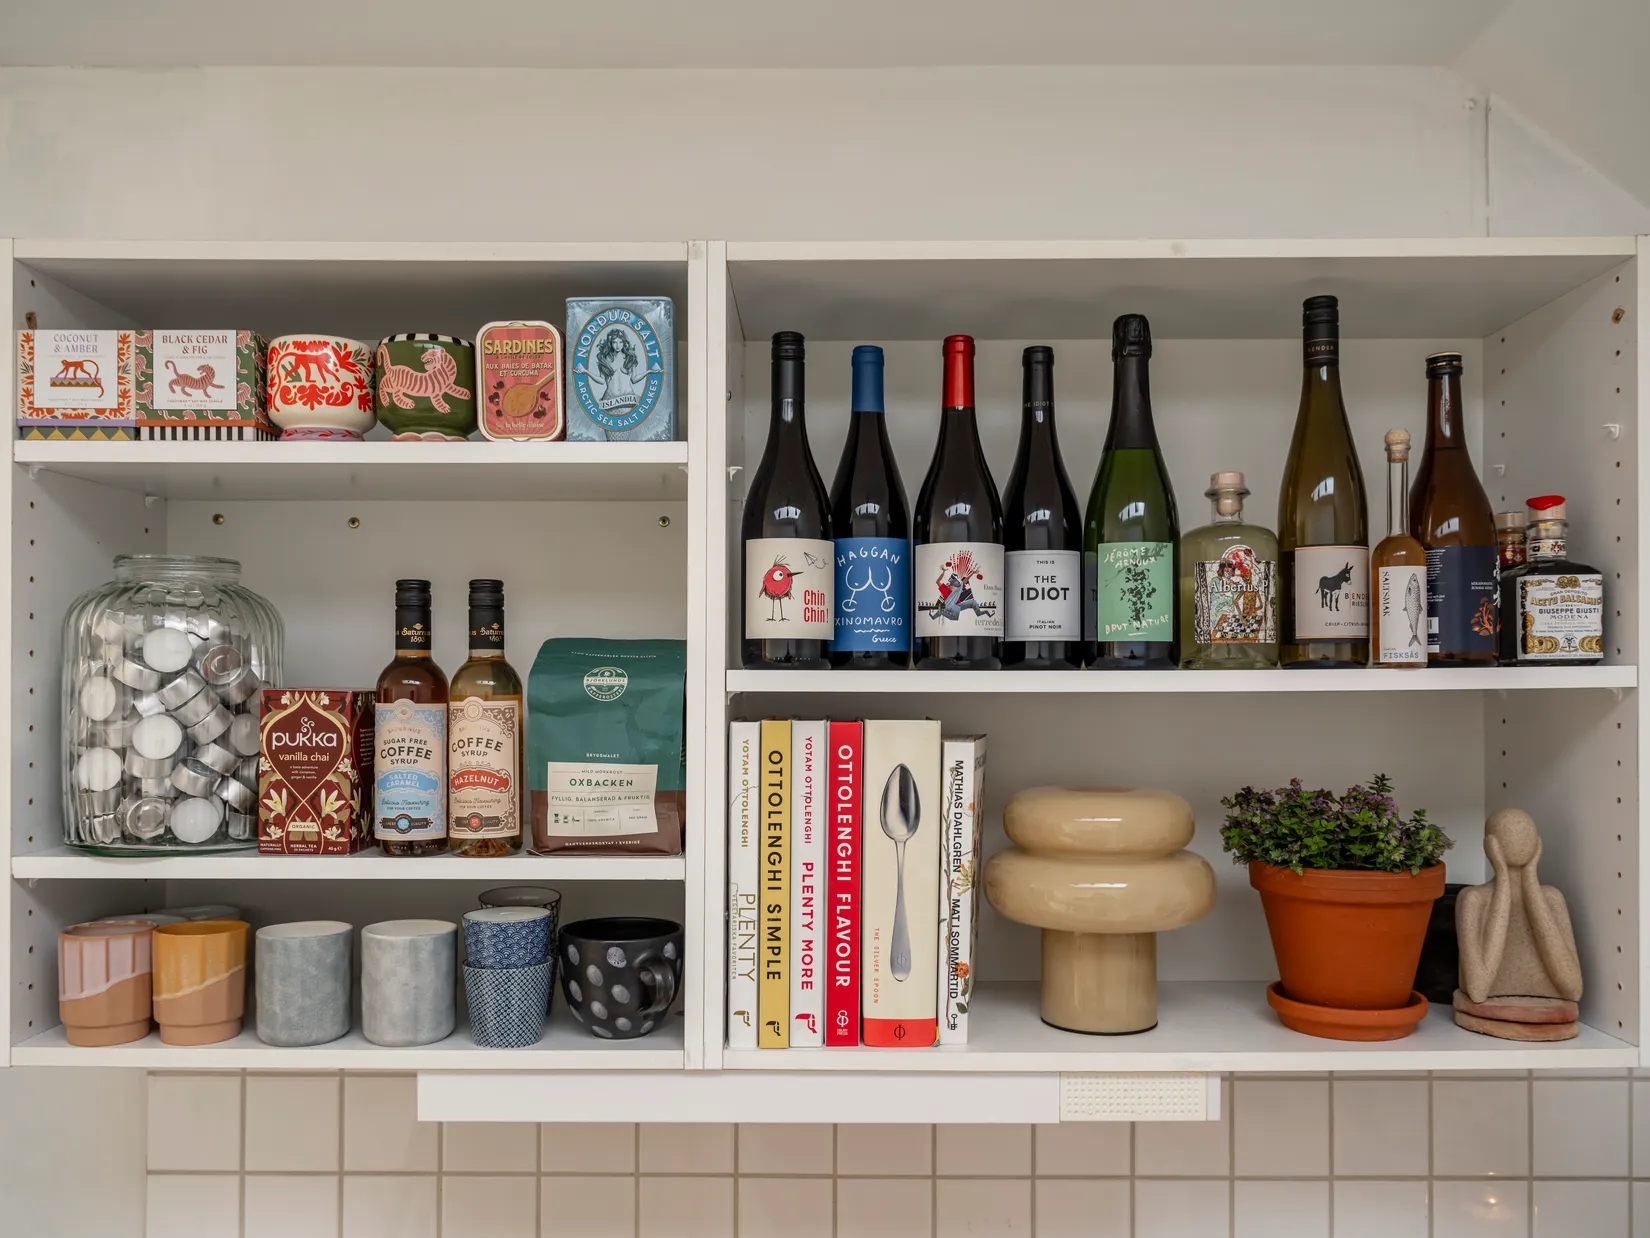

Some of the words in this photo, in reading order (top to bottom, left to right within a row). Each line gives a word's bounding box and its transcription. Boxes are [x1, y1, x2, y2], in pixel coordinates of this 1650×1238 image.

[54, 334, 99, 342] COCONUT
[162, 335, 193, 344] BLACK
[196, 335, 228, 344] CEDAR
[634, 320, 660, 358] SALT
[54, 345, 60, 353] &
[64, 344, 98, 353] AMBER
[182, 346, 189, 354] &
[193, 346, 208, 354] FIG
[484, 338, 554, 355] SARDINES
[577, 381, 598, 415] ARCTIC
[597, 414, 614, 427] SEA
[617, 413, 639, 427] SALT
[639, 380, 658, 414] FLAKES
[602, 396, 638, 408] ISLANDIA
[837, 547, 900, 566] HAGGAN
[1104, 547, 1147, 564] JÉRÔME
[1115, 556, 1157, 568] ARNOUX
[1034, 575, 1056, 583] THE
[1210, 580, 1259, 592] Albertus
[804, 590, 825, 606] Chin
[1020, 587, 1070, 601] IDIOT
[1530, 596, 1558, 606] ACETO
[1560, 595, 1602, 605] BALSAMIC
[804, 607, 829, 623] Chin!
[835, 617, 903, 626] XINOMAVRO
[1105, 622, 1128, 635] BRUT
[1132, 614, 1169, 629] NATURE
[872, 635, 897, 643] Greece
[1384, 650, 1419, 659] FISKSÅS
[272, 729, 336, 750] pukka
[451, 738, 503, 753] COFFEE
[279, 752, 308, 761] vanilla
[310, 752, 329, 761] chai
[381, 746, 432, 760] COFFEE
[804, 736, 812, 772] YOTAM
[386, 780, 420, 788] CARAMEL
[454, 775, 499, 786] HAZELNUT
[569, 778, 633, 787] OXBACKEN
[954, 760, 964, 809] MATHIAS
[767, 750, 783, 891] OTTOLENGHI
[836, 745, 853, 881] OTTOLENGHI
[952, 812, 962, 873] DAHLGREN
[801, 862, 814, 931] PLENTY
[951, 898, 960, 921] MAT
[738, 893, 756, 982] PLENTY
[766, 904, 782, 980] SIMPLE
[835, 893, 852, 987] FLAVOUR
[801, 940, 814, 990] MORE
[950, 931, 960, 998] SOMMARTID
